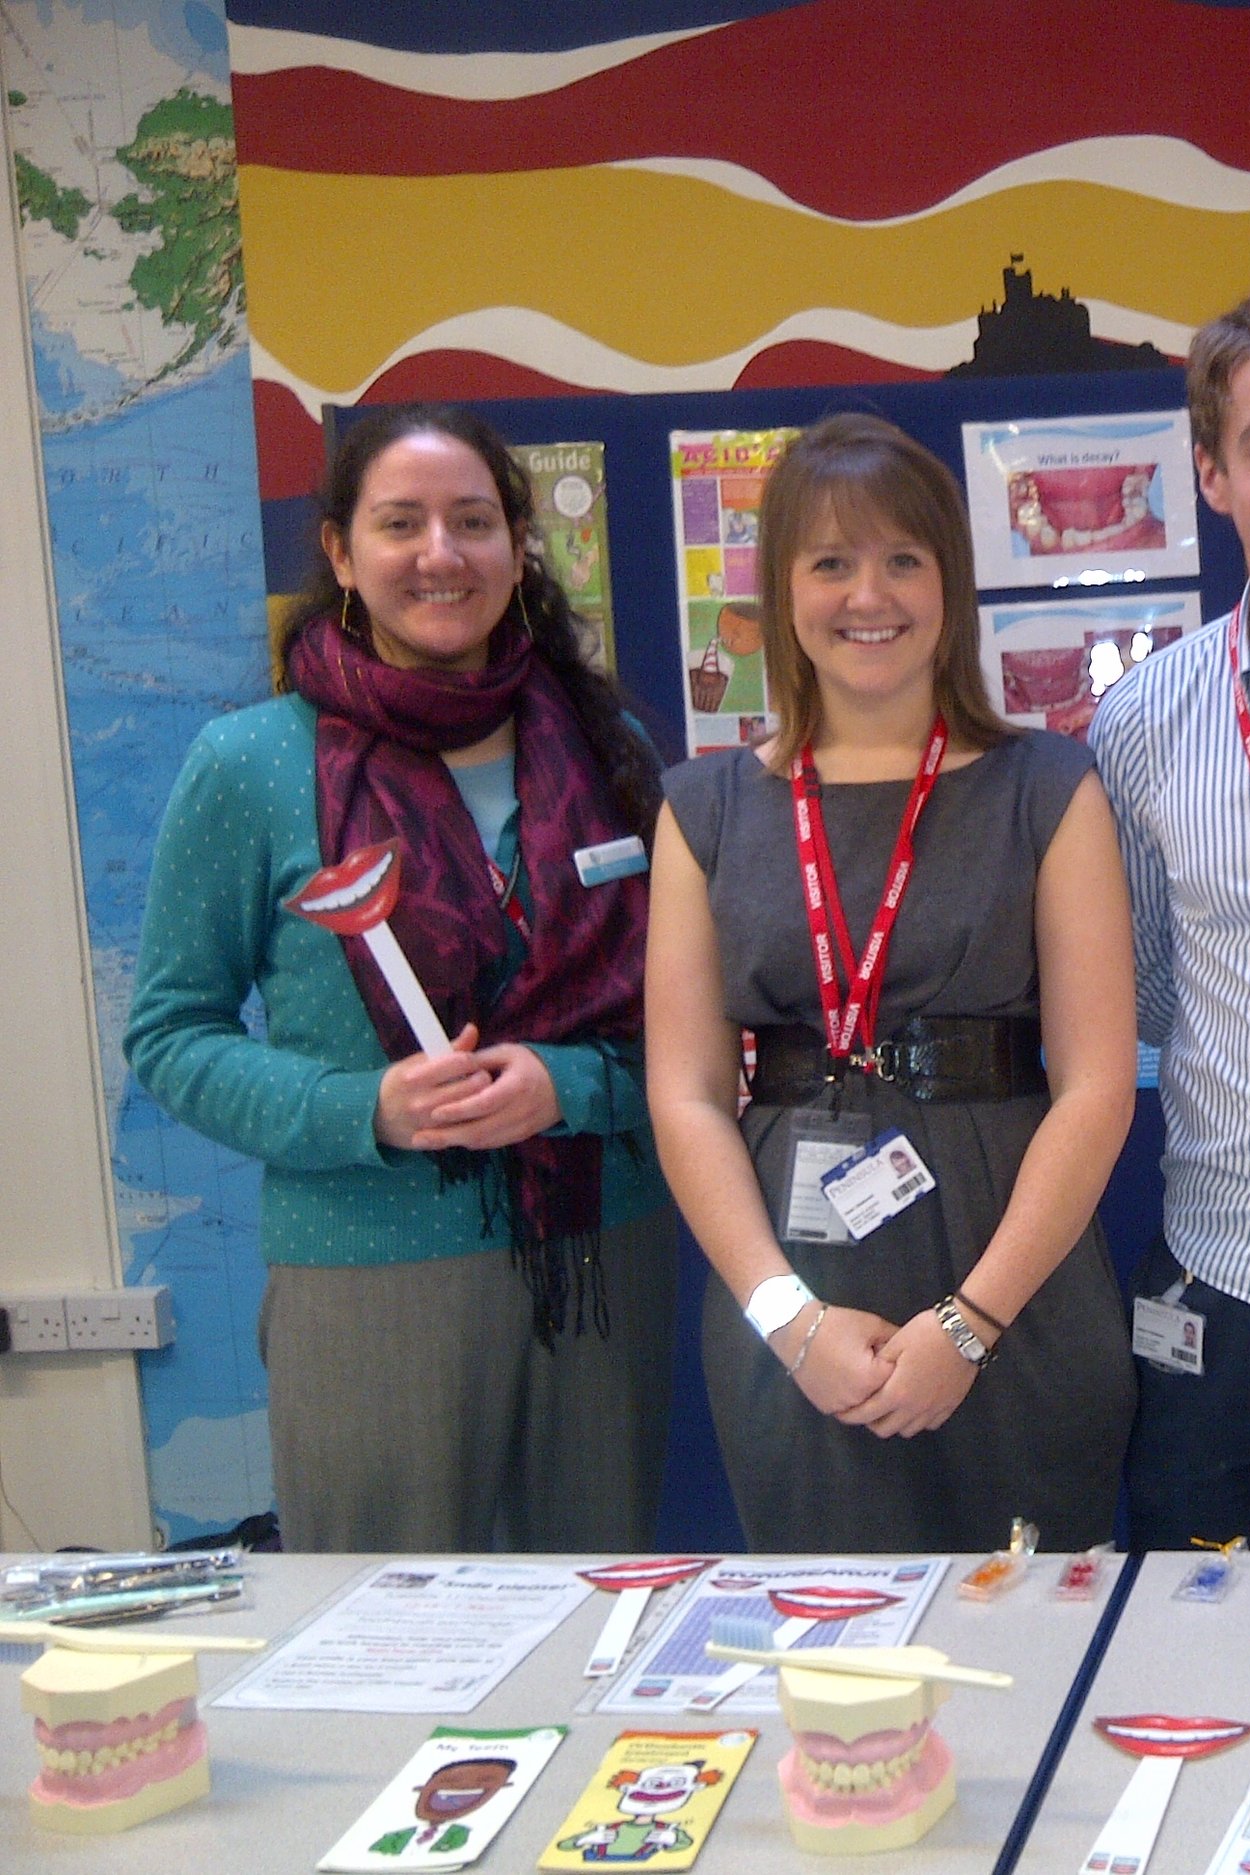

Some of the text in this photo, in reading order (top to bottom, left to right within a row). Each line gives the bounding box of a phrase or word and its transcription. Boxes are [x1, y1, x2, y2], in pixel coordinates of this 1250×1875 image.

[529, 451, 591, 473] Guide
[1037, 451, 1121, 466] What is decay?
[797, 797, 812, 842] VISITOR
[805, 861, 822, 911] VISITOR
[887, 860, 909, 909] VISITOR
[816, 932, 834, 984] VISITOR
[859, 931, 885, 981] VISITOR
[840, 1003, 861, 1051] VISITOR
